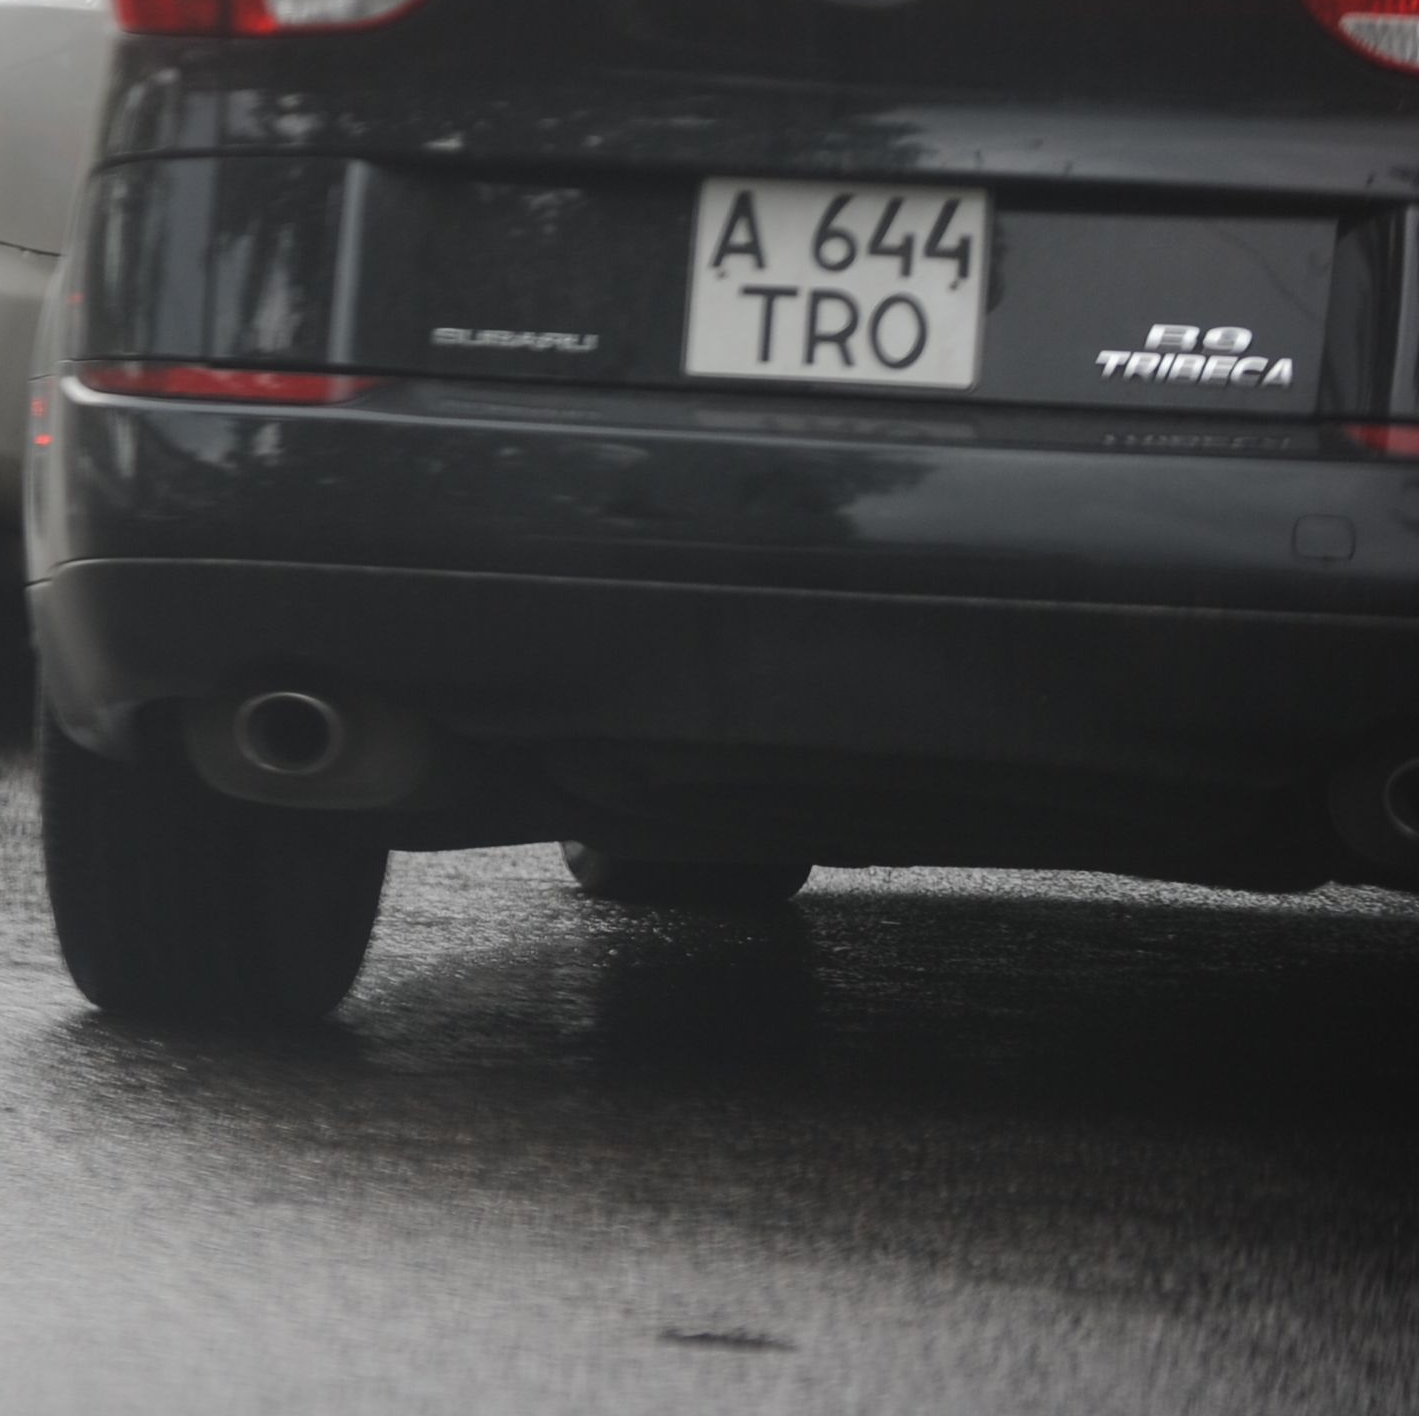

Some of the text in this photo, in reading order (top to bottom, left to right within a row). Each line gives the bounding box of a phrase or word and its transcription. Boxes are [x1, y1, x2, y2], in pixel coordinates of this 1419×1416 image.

[709, 189, 971, 279] A 644
[432, 327, 599, 352] SUBARU
[740, 286, 928, 370] TRO
[1094, 349, 1294, 388] TRIBECA
